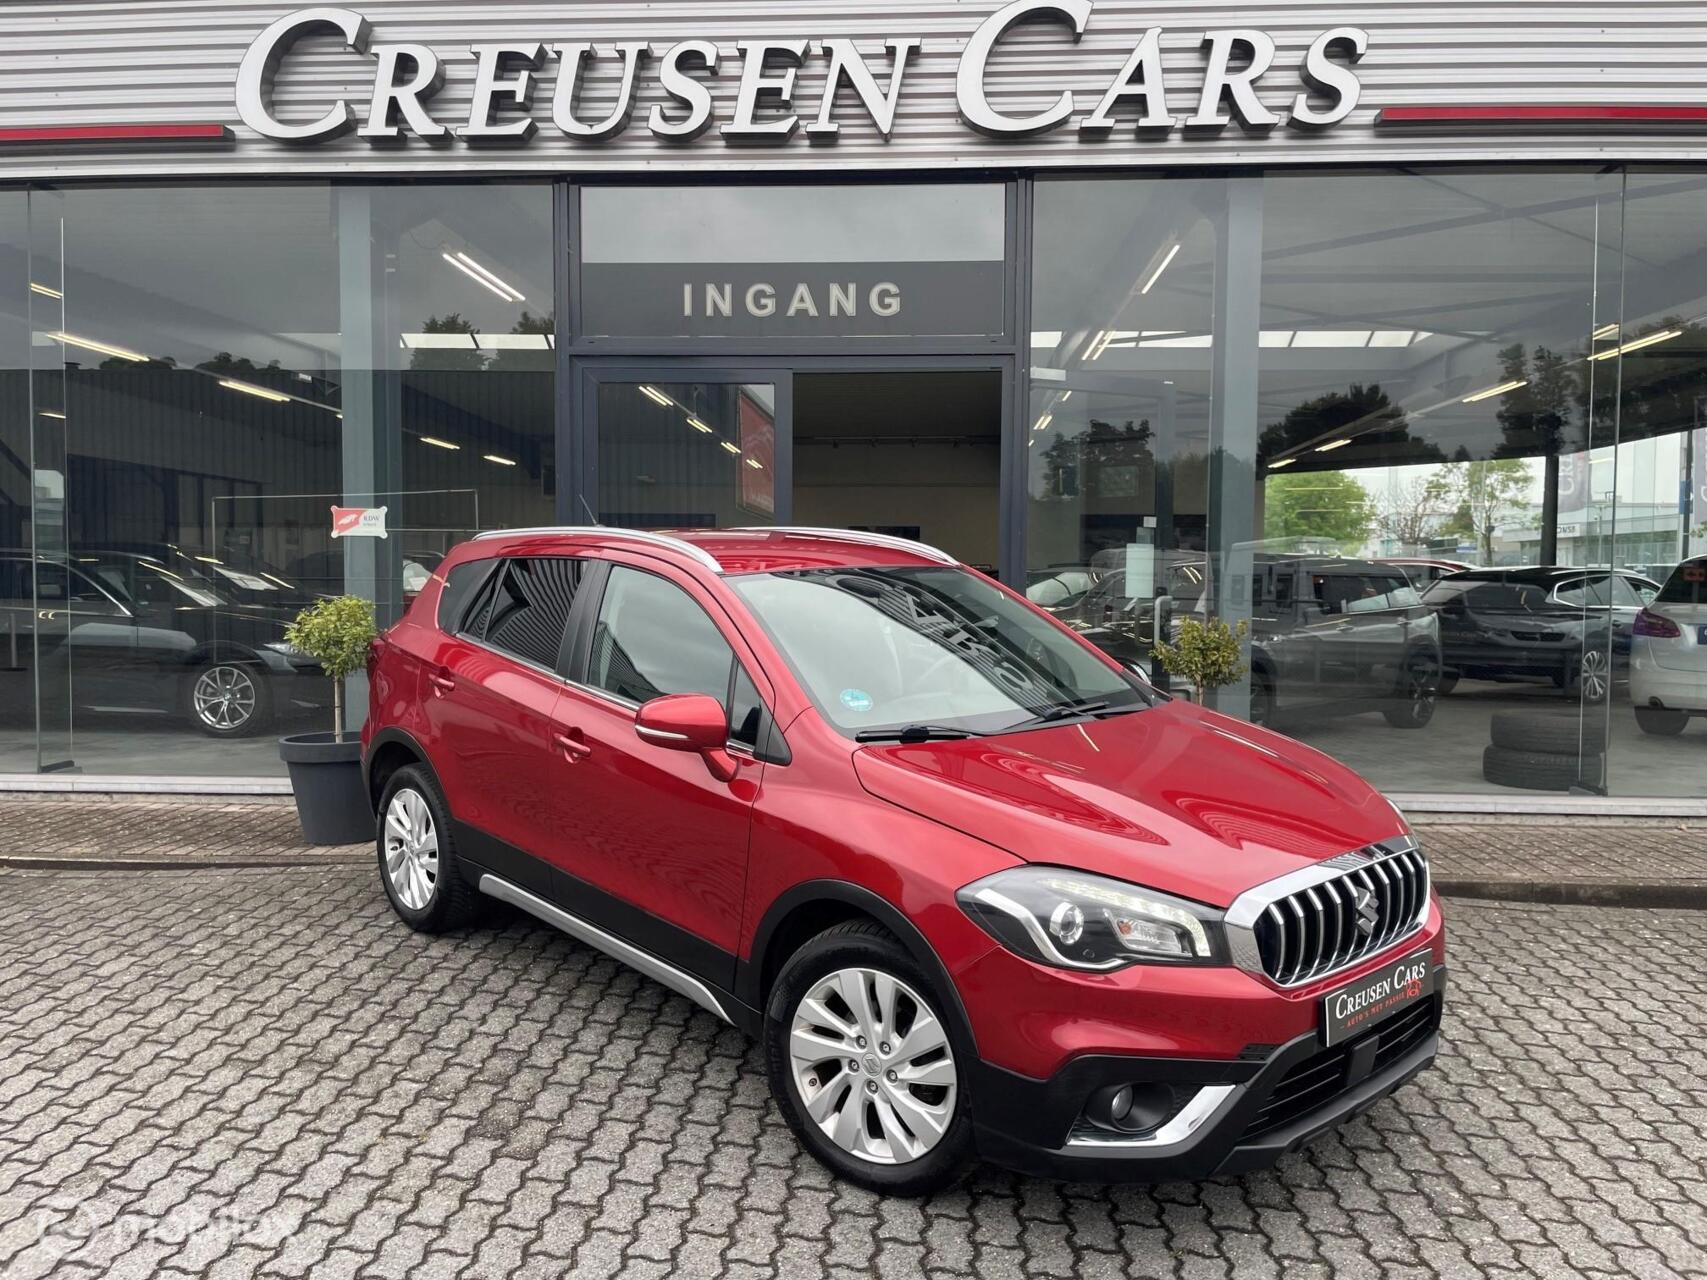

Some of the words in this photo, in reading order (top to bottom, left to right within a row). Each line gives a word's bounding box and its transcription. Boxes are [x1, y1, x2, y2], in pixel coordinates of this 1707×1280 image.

[235, 7, 922, 142] CREUSEN
[956, 0, 1369, 133] CARS
[683, 282, 902, 318] INGANG
[1335, 978, 1391, 1019] CREUSEN
[1394, 962, 1426, 989] CARS
